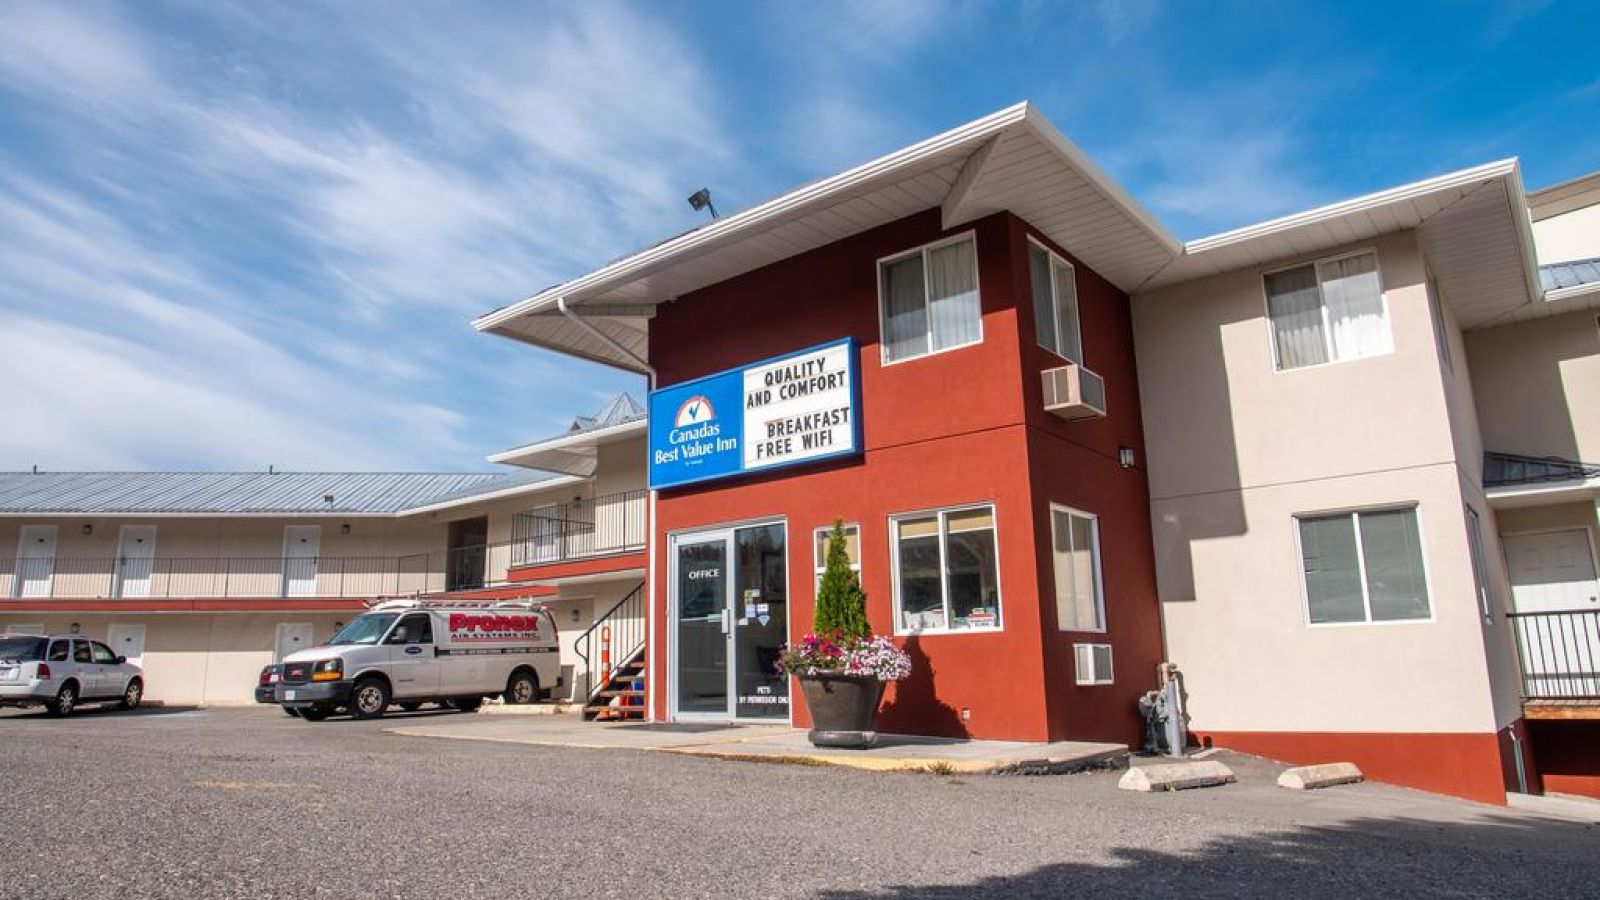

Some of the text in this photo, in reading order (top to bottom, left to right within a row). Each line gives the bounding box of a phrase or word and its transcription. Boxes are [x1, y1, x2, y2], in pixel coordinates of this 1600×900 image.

[764, 357, 826, 387] QUALITY
[747, 370, 845, 410] AND COMFORT
[669, 421, 720, 444] Canadas
[768, 406, 849, 438] BREAKFAST
[655, 437, 737, 464] Best Value Inn
[757, 429, 832, 459] FREE WIFI
[688, 569, 720, 579] OFFICE
